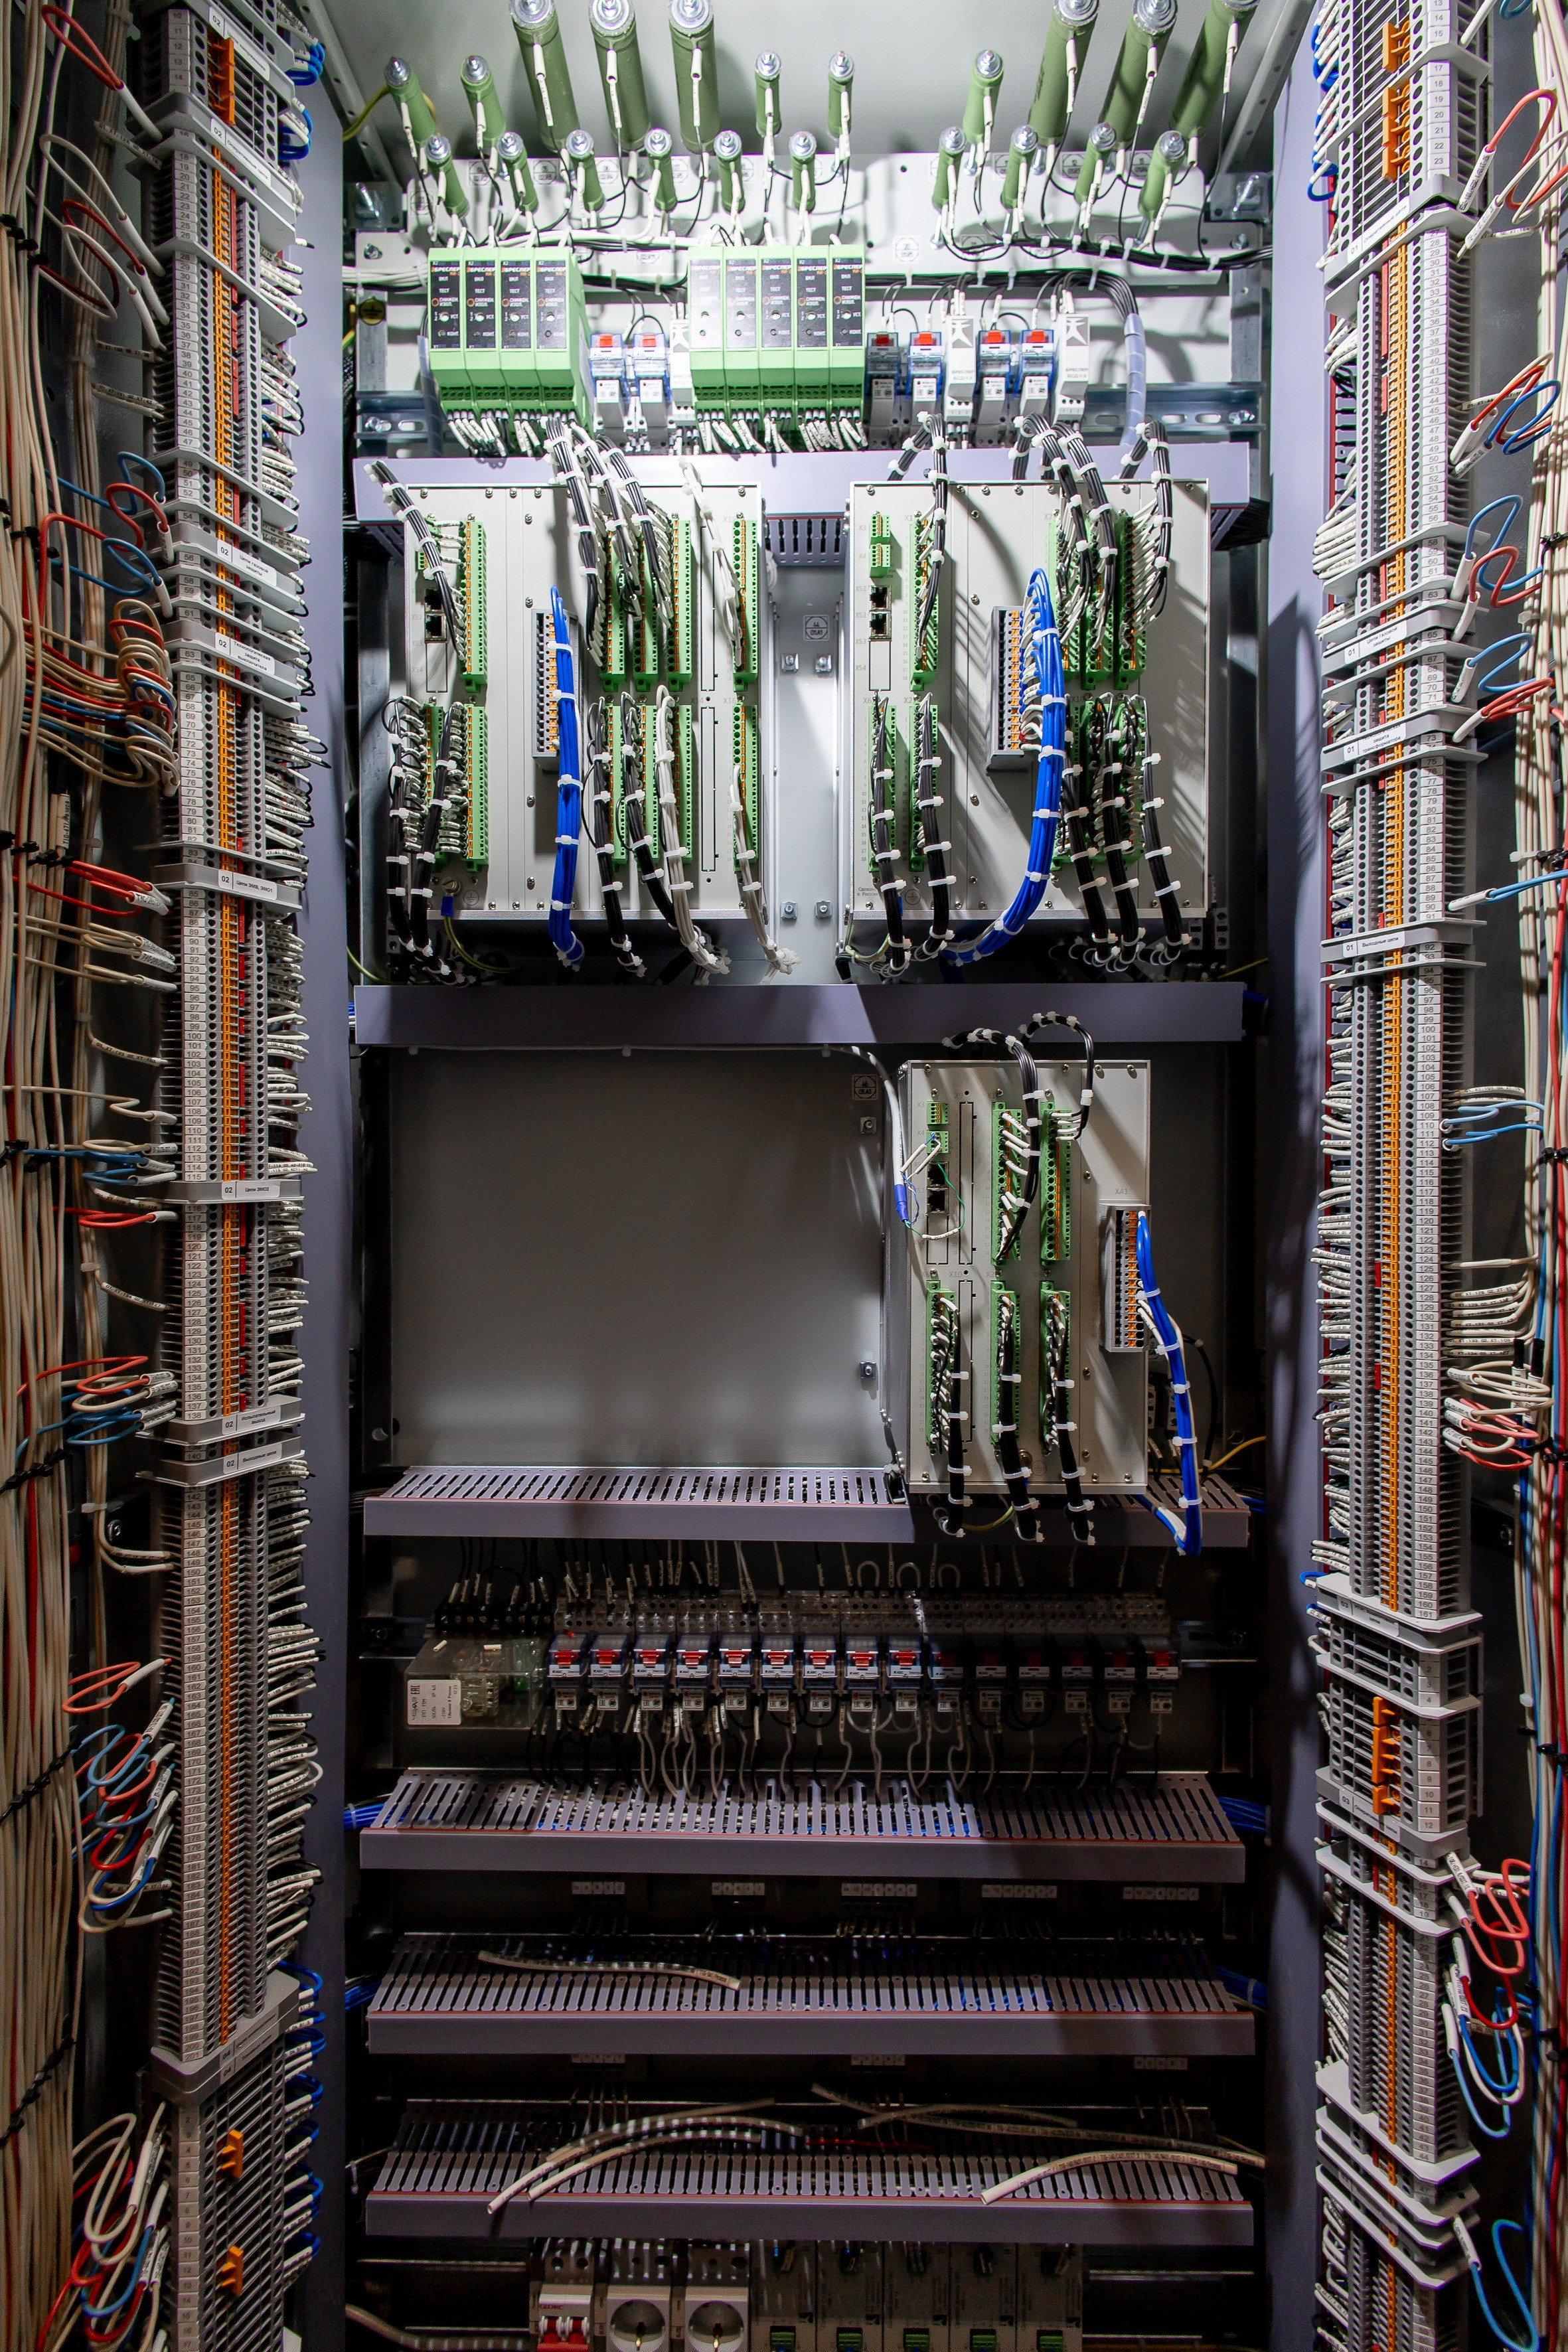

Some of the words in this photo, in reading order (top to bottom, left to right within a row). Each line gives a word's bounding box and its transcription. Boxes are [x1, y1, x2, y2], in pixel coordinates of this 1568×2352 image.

[212, 15, 220, 27] 02
[214, 127, 222, 139] 02
[179, 173, 191, 182] 20
[1351, 244, 1358, 254] 01
[220, 547, 228, 556] 02
[240, 555, 251, 564] Цепи
[252, 562, 269, 573] газовой
[246, 565, 263, 576] защиты
[218, 639, 226, 648] 02
[234, 641, 271, 661] Технологическая
[238, 655, 267, 670] выключателя
[245, 653, 260, 662] защита
[1373, 734, 1389, 743] защита
[1363, 736, 1401, 753] трансформатора
[410, 1685, 420, 1695] EAC
[1342, 1796, 1350, 1805] 03
